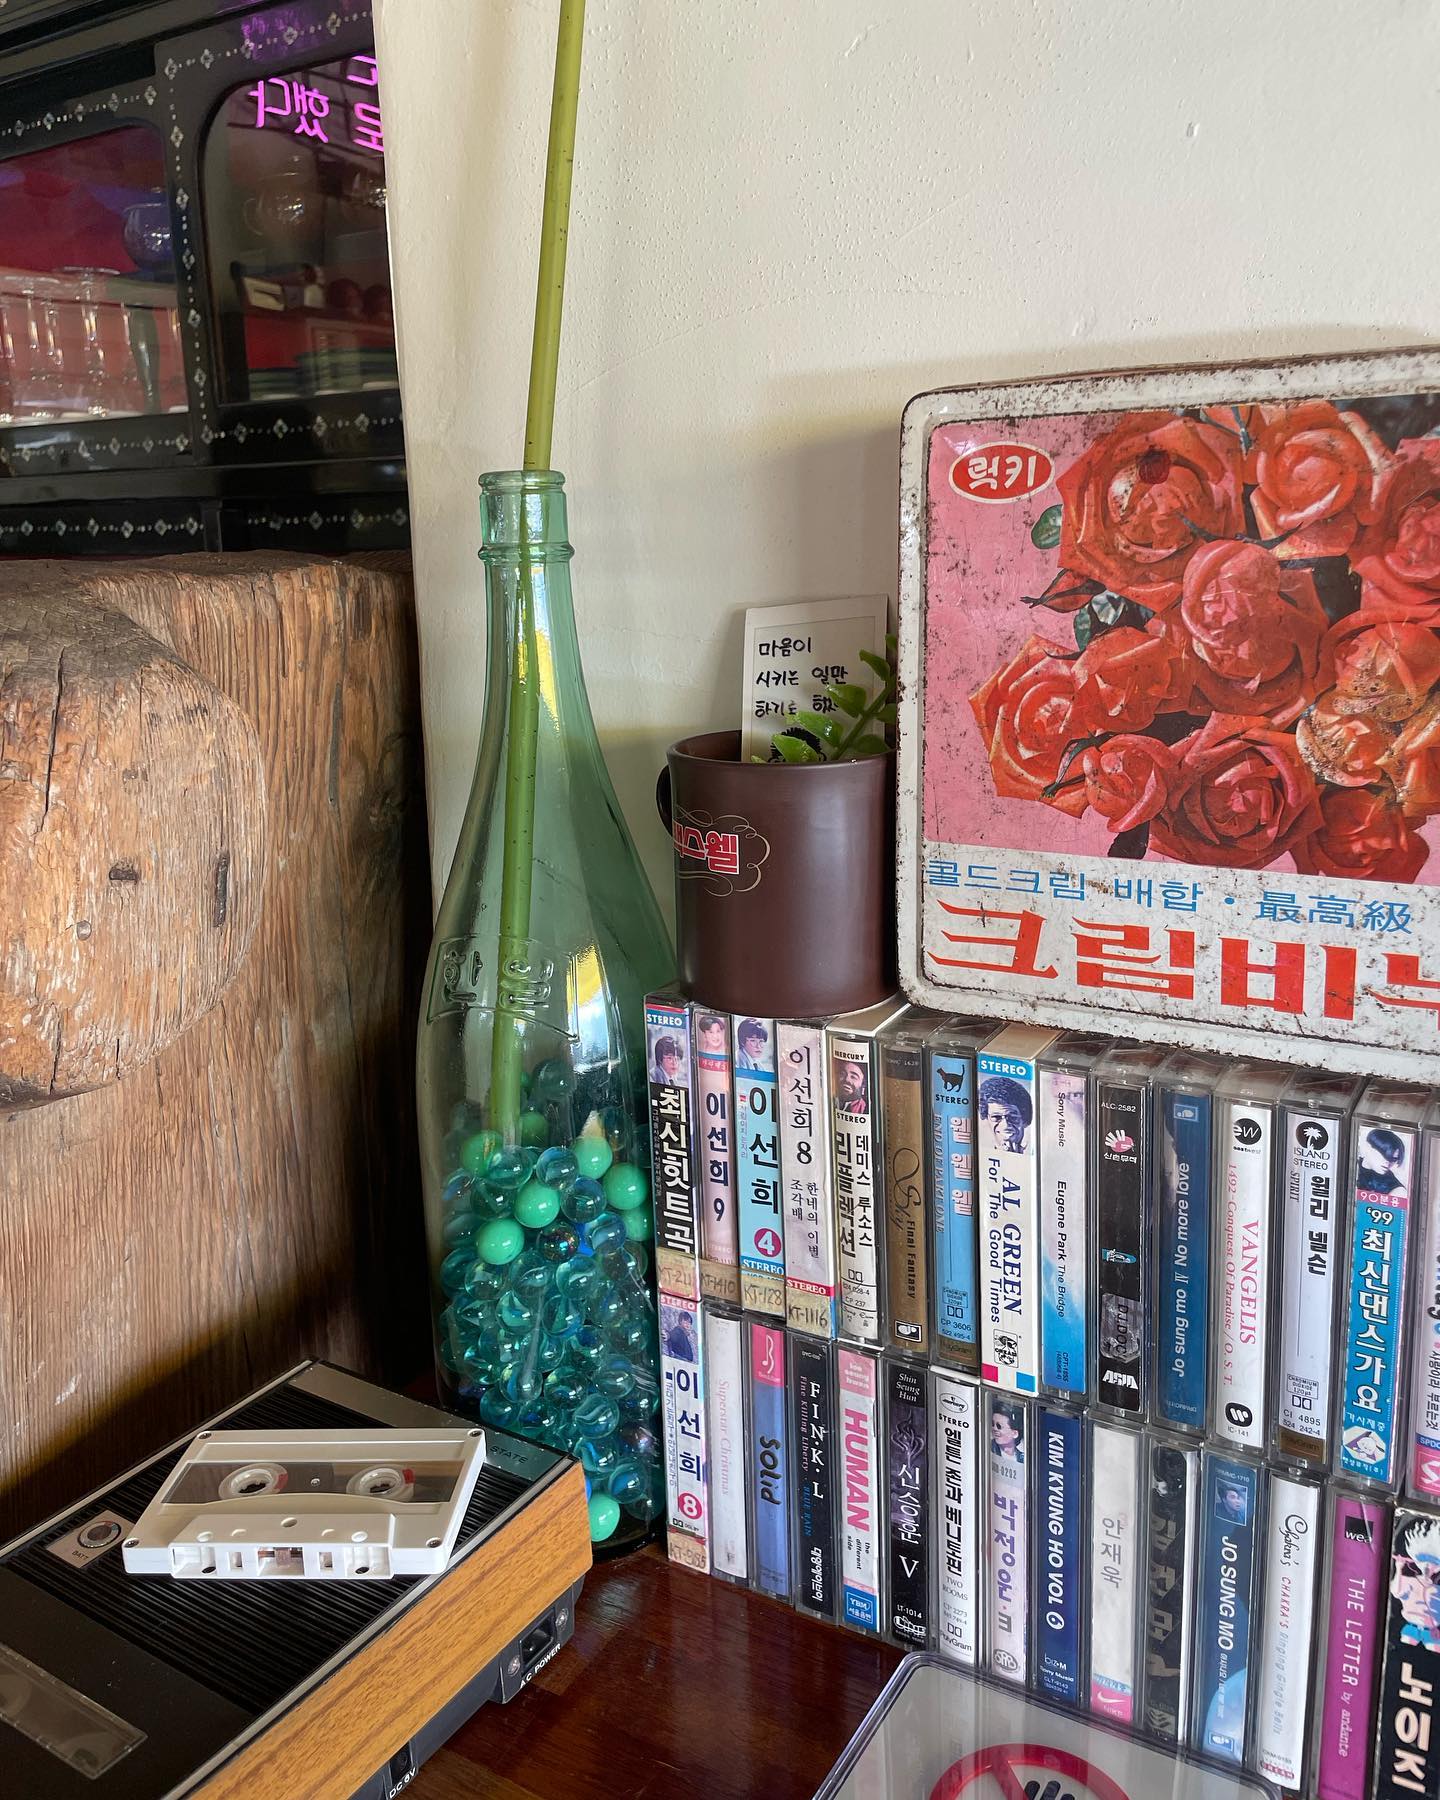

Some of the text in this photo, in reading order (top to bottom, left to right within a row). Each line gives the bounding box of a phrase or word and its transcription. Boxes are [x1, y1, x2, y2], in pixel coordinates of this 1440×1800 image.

[968, 455, 1037, 490] 럭키
[758, 637, 812, 657] 마음이
[756, 666, 848, 688] 시키는 일만
[925, 859, 1412, 935] 콜드크림 배합 最高級
[646, 1013, 683, 1026] STEREO
[834, 1050, 864, 1060] MERCURY
[980, 1060, 1027, 1076] STEREO
[789, 1046, 813, 1165] 이선희 8
[935, 1094, 970, 1105] STEREO
[836, 1112, 866, 1123] STEREO
[706, 1092, 728, 1187] 이선희
[750, 1087, 779, 1214] 이선희
[1294, 1147, 1331, 1160] ISLAND
[1294, 1158, 1329, 1170] STEREO
[790, 1179, 803, 1220] 조각배
[855, 1134, 873, 1247] 데미스 루소스
[1290, 1171, 1300, 1203] SPIRIT
[1360, 1191, 1400, 1207] 90분용
[713, 1197, 725, 1222] 9
[1057, 1181, 1067, 1228] Eugene
[988, 1158, 1001, 1323] For The Good Times
[1225, 1201, 1237, 1257] Conquest
[757, 1231, 775, 1256] 4
[1003, 1177, 1022, 1315] AL GREEN
[1057, 1234, 1067, 1261] Park
[742, 1259, 784, 1276] STEREO
[906, 1221, 916, 1299] Final Fantasy
[1172, 1162, 1190, 1377] Jo sung mo No more love
[1058, 1265, 1066, 1283] The
[1240, 1220, 1260, 1345] VANGELIS
[743, 1284, 782, 1306] KT-128
[787, 1279, 827, 1295] STEREO
[660, 1296, 695, 1310] STEREO
[1352, 1227, 1393, 1413] 최신댄스가요
[896, 1382, 921, 1396] Seung
[899, 1373, 917, 1384] Shin
[899, 1391, 917, 1402] Hun
[938, 1413, 970, 1429] STEREO
[1227, 1425, 1249, 1437] IC-141
[1298, 1414, 1321, 1427] 4895
[1299, 1425, 1321, 1436] 242-4
[489, 1445, 528, 1464] STATE
[676, 1369, 702, 1517] 이선희 8
[844, 1408, 870, 1532] HUMAN
[898, 1463, 921, 1579] 신승훈 V
[1046, 1432, 1065, 1630] KIM KYUNG HO VOL 6
[1101, 1517, 1124, 1589] 안재욱
[943, 1583, 968, 1600] ROOMS
[946, 1577, 963, 1588] TWO
[1218, 1536, 1237, 1650] JO SUNG MO
[897, 1604, 922, 1619] LT-1014
[1279, 1577, 1292, 1629] CHAKRA'S
[534, 1643, 561, 1675] POWER
[1339, 1578, 1366, 1758] THE LETTER by andante
[389, 1781, 403, 1799] DC
